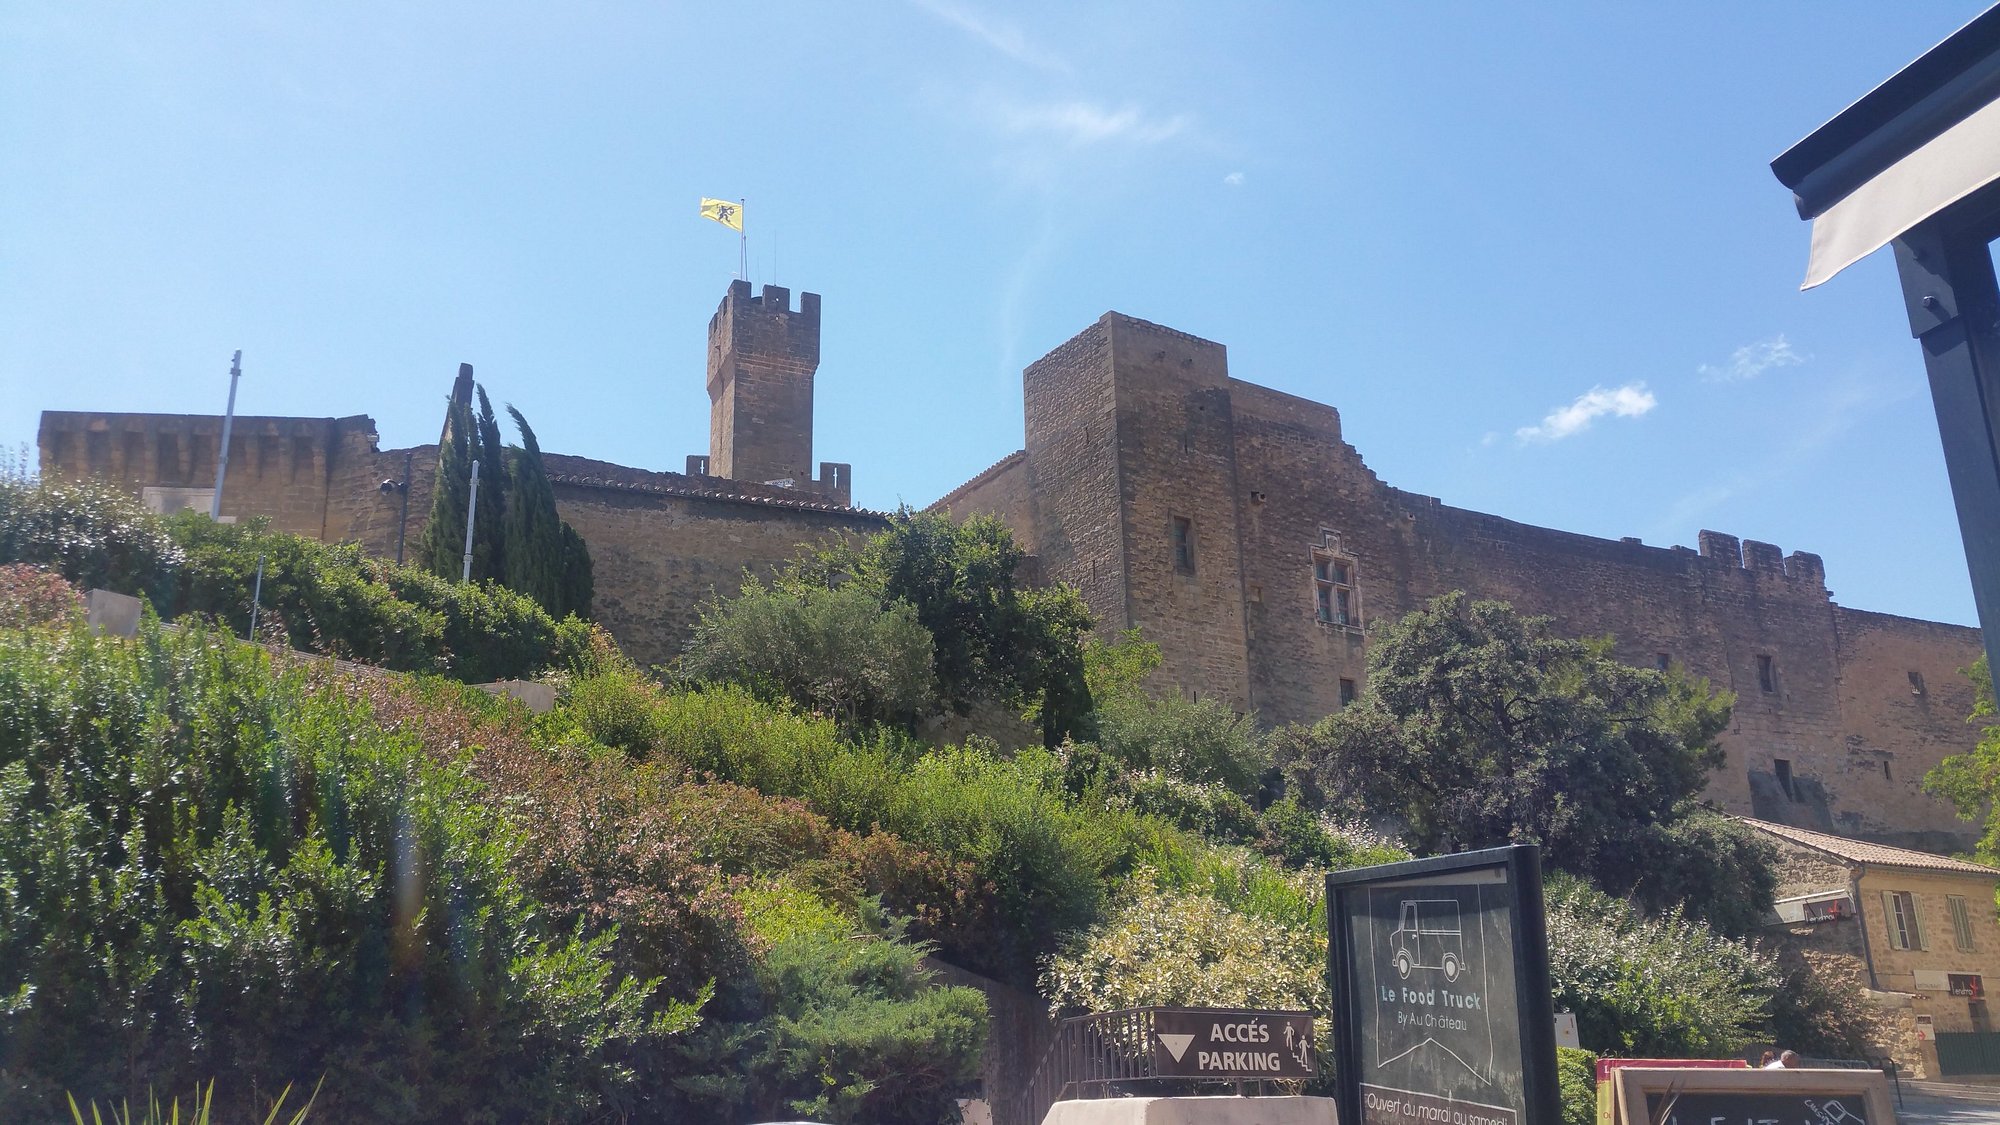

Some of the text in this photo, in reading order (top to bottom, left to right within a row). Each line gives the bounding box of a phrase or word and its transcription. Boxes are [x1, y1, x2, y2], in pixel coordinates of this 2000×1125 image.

[1381, 985, 1481, 1010] Le Food Truck
[1210, 1020, 1270, 1043] ACCÉS
[1398, 1011, 1467, 1031] By Au Château
[1198, 1051, 1281, 1071] PARKING
[1367, 1093, 1401, 1114] Ouvert
[1403, 1100, 1416, 1117] du
[1418, 1105, 1451, 1123] mardi
[1453, 1111, 1467, 1125] au
